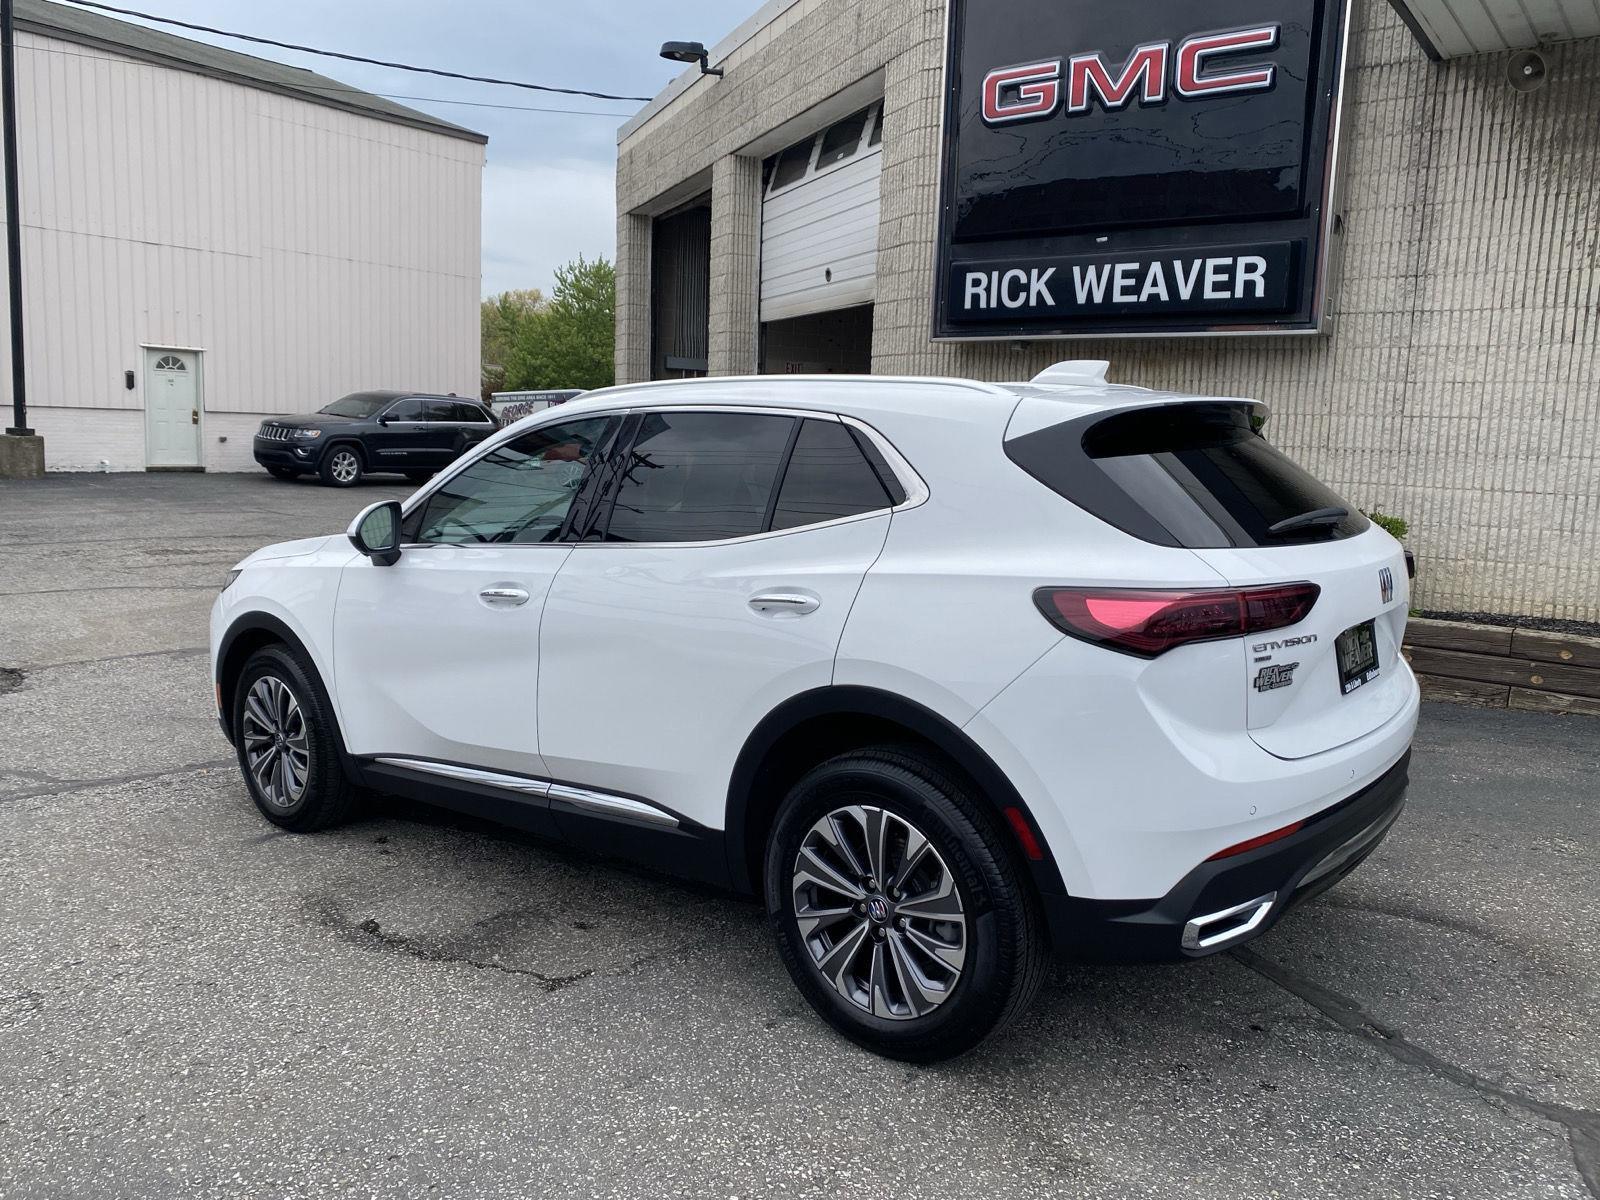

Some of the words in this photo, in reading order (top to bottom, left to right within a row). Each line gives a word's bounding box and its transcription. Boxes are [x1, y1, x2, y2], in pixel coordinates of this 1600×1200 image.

[981, 26, 1277, 124] GMC
[963, 267, 1057, 310] RICK
[1072, 255, 1267, 304] WEAVER
[785, 362, 802, 374] EXIT
[501, 399, 534, 419] GEORGE
[1252, 634, 1317, 652] ENVISION
[1256, 671, 1293, 687] WEAVER
[1261, 666, 1279, 678] RICK
